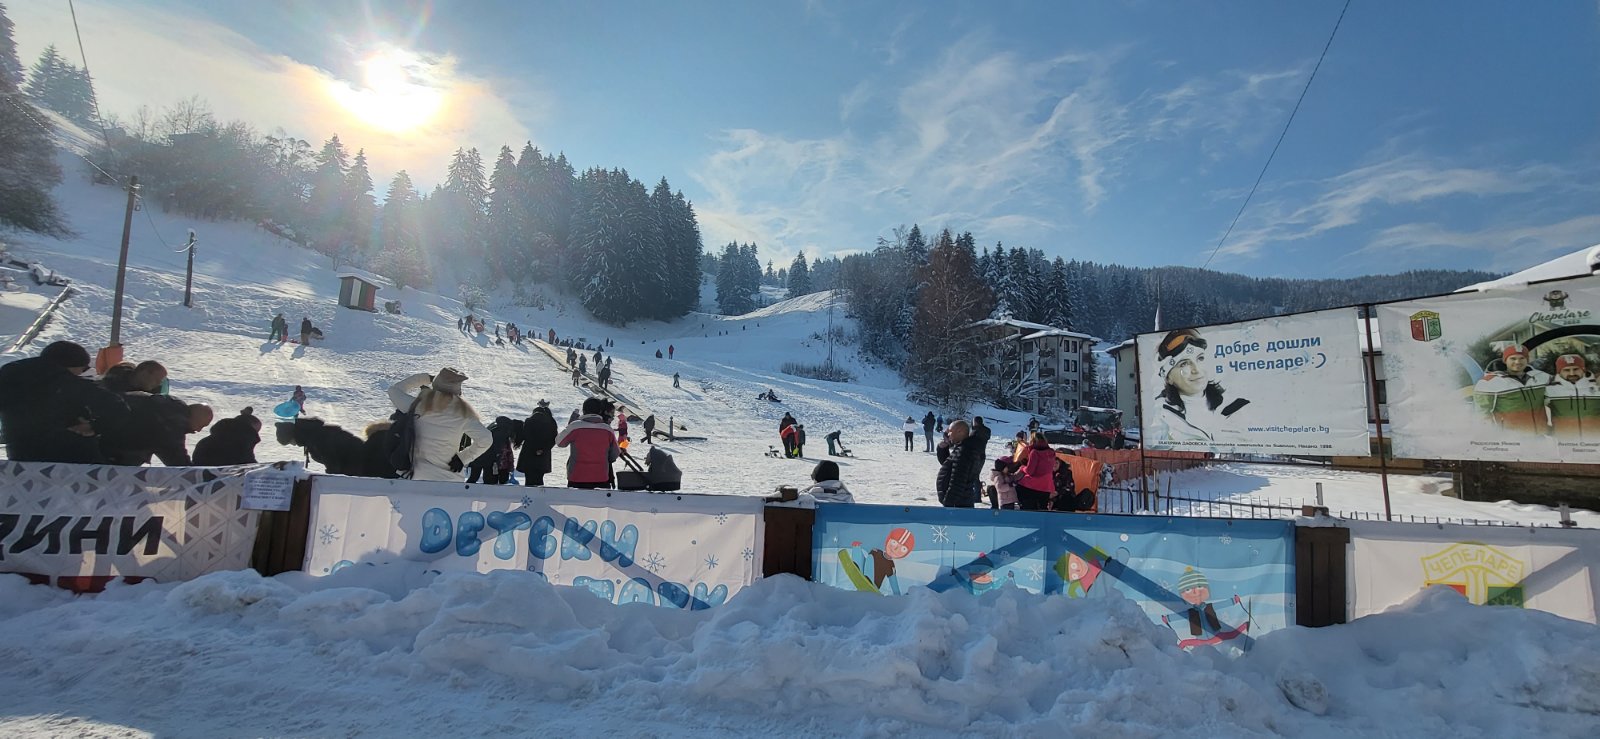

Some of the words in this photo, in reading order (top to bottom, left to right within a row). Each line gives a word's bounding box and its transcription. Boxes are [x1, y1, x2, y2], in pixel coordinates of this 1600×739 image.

[1529, 309, 1590, 323] Chepelare
[1214, 341, 1260, 358] Добре
[1266, 337, 1321, 352] дошли
[1215, 365, 1224, 374] в
[1229, 357, 1304, 372] Чепеларе
[1247, 425, 1330, 434] www.visitchepelare.bg
[419, 507, 639, 568] ДЕТСКИ
[1429, 549, 1518, 579] ЧЕПЕЛАРЕ
